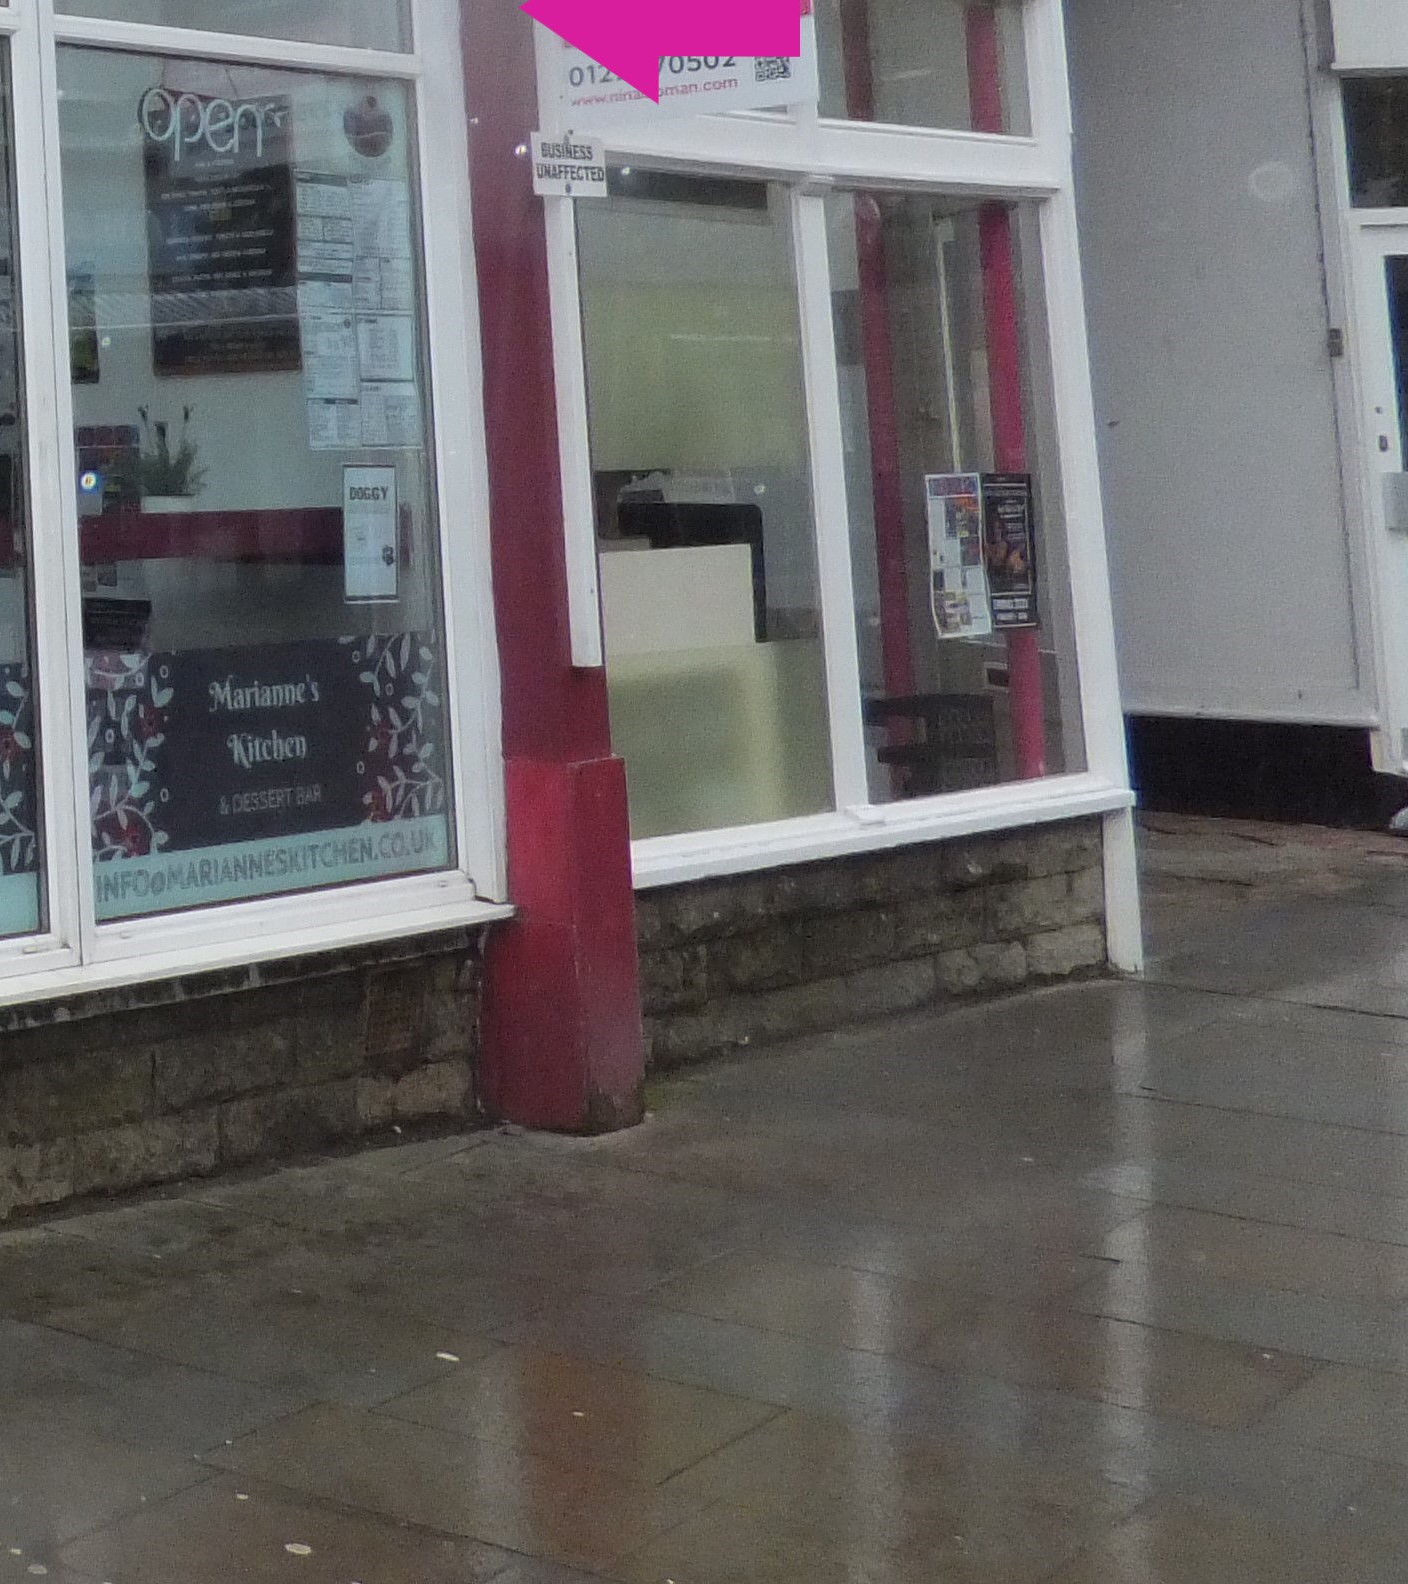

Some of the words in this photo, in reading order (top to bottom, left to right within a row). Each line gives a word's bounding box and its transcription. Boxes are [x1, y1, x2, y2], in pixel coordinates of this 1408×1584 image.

[541, 142, 593, 161] BUSINESS
[536, 162, 604, 182] UNAFFECTED
[349, 486, 389, 501] DOGGY
[208, 673, 320, 713] Marianne's
[226, 730, 307, 769] Kitchen
[233, 786, 294, 814] DESSERT
[297, 784, 323, 805] BAR
